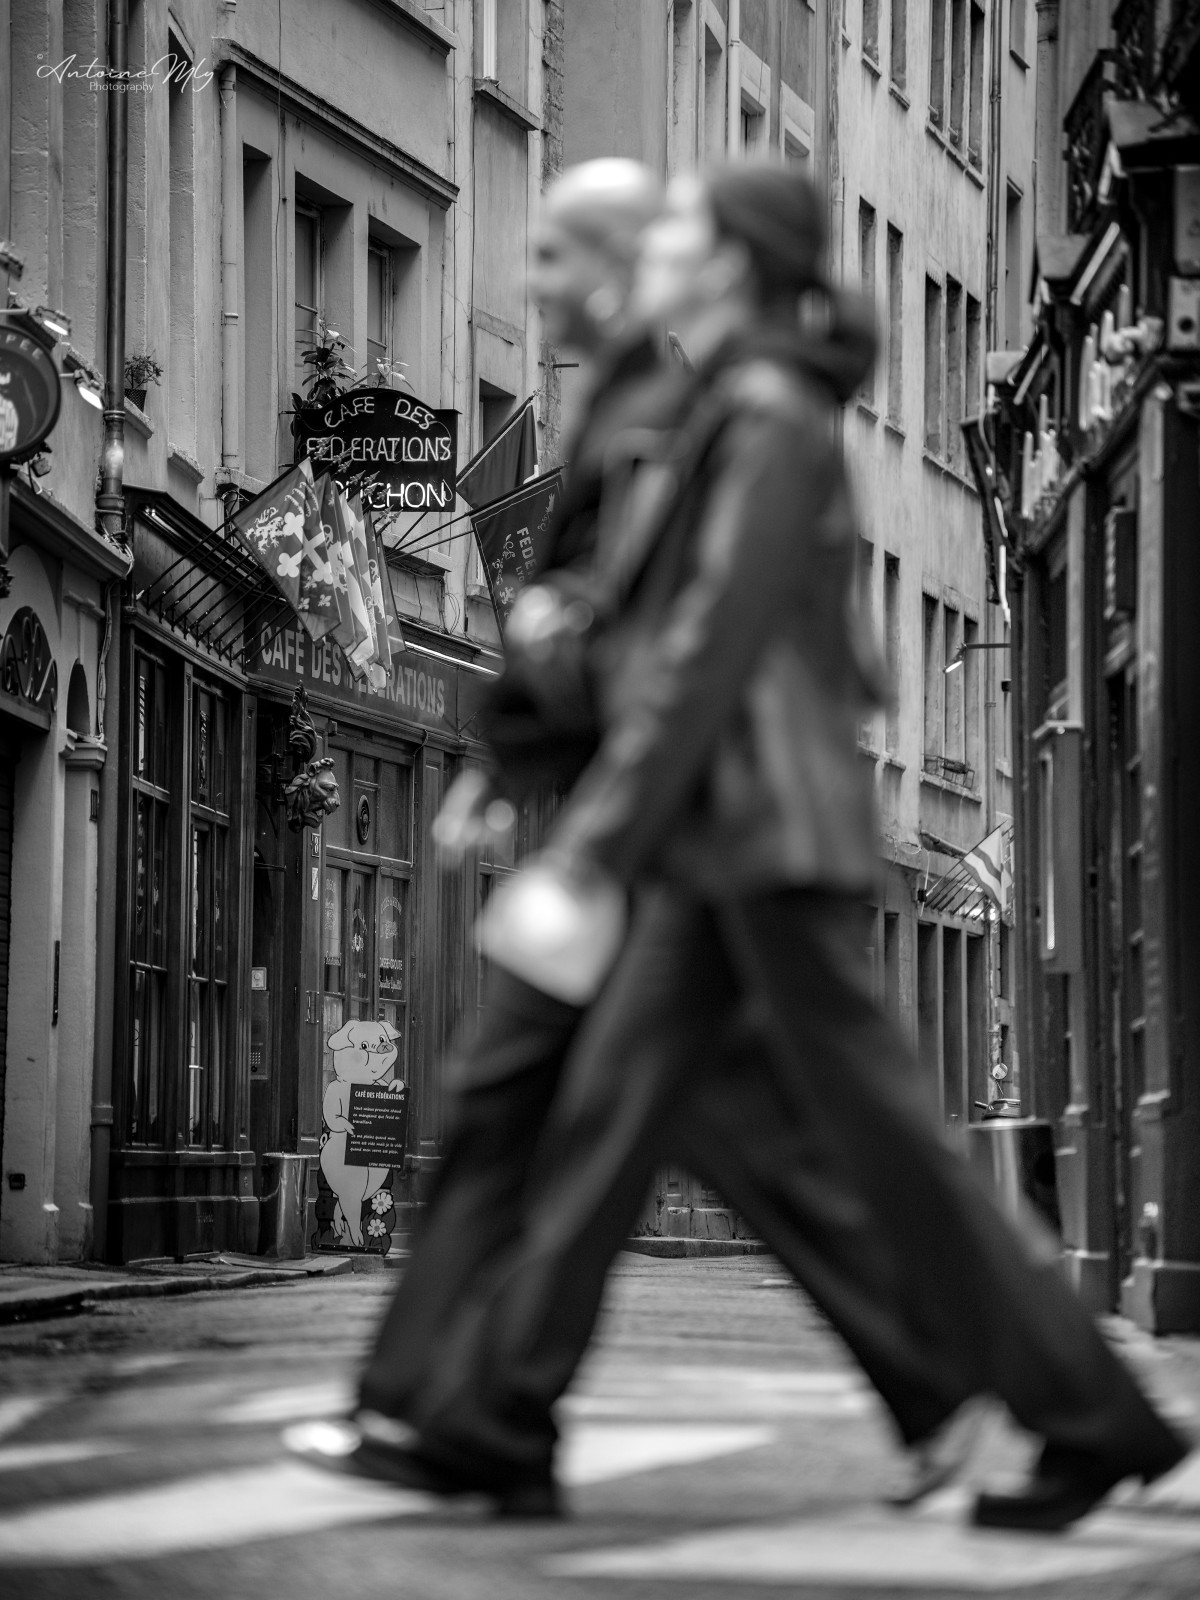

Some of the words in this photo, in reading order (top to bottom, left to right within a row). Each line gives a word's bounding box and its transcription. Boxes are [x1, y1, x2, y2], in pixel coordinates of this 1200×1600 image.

[324, 396, 375, 428] CAFE
[394, 398, 435, 430] DES
[334, 480, 446, 509] CHON
[260, 620, 305, 675] CAFÉ
[311, 641, 342, 687] DES
[349, 660, 445, 719] RATIONS
[354, 1090, 366, 1098] CAFÉ
